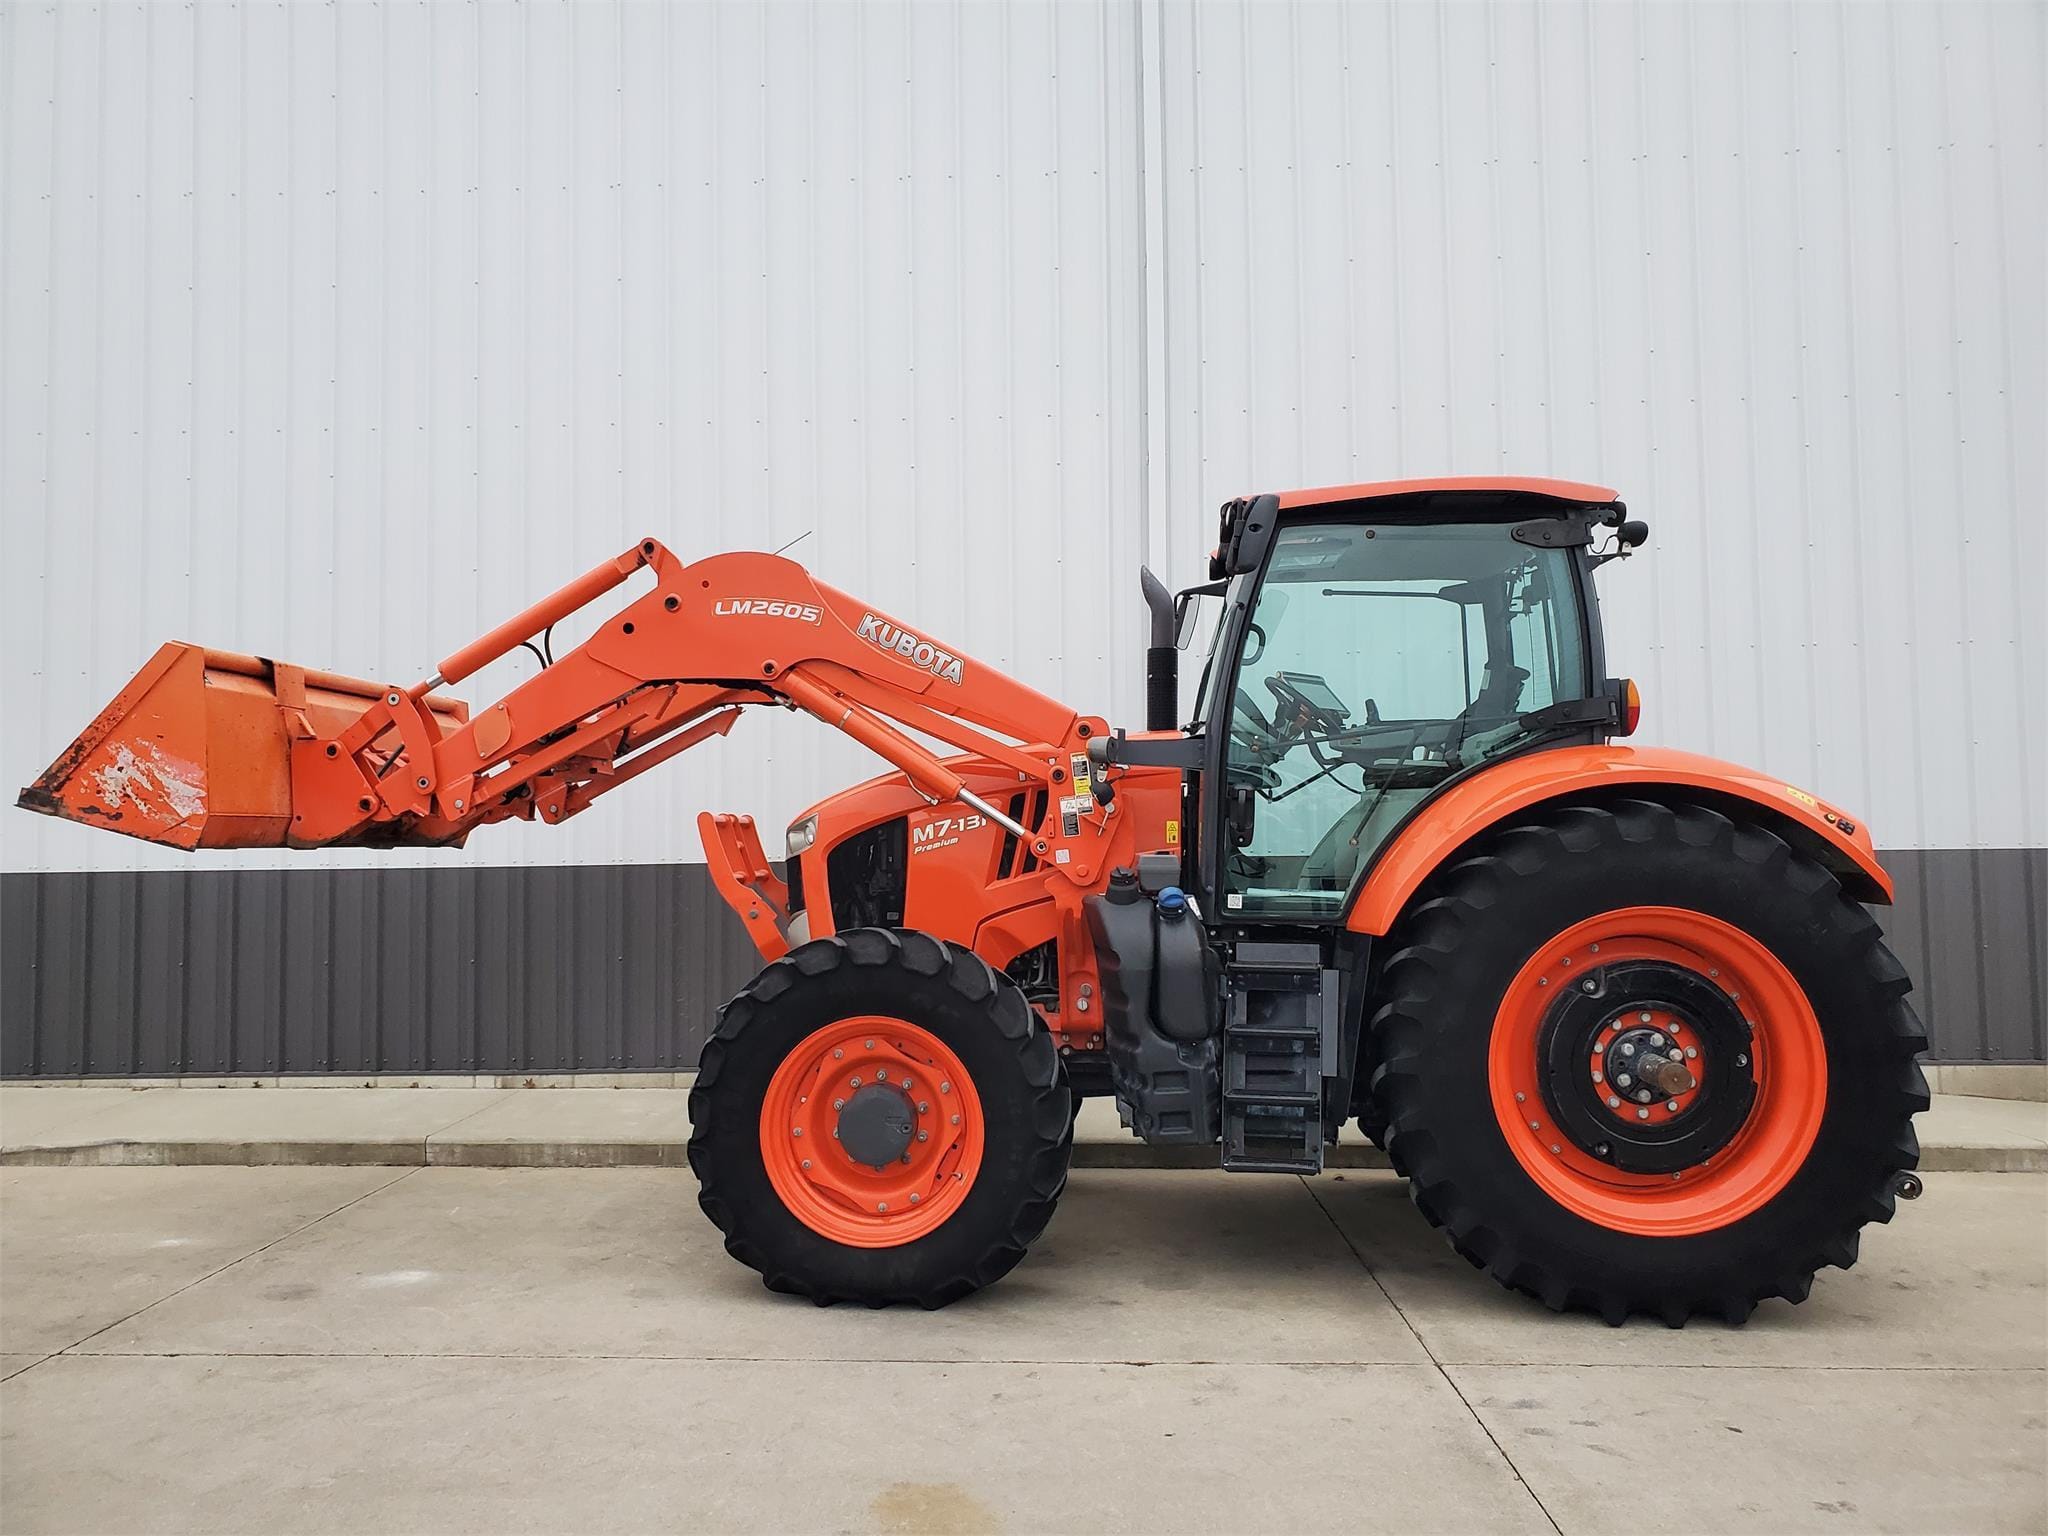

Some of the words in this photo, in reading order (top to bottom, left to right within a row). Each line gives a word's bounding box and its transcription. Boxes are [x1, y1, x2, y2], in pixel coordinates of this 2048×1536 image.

[714, 600, 820, 622] LM2605
[860, 613, 962, 684] KUBOTA
[914, 837, 959, 855] Premium
